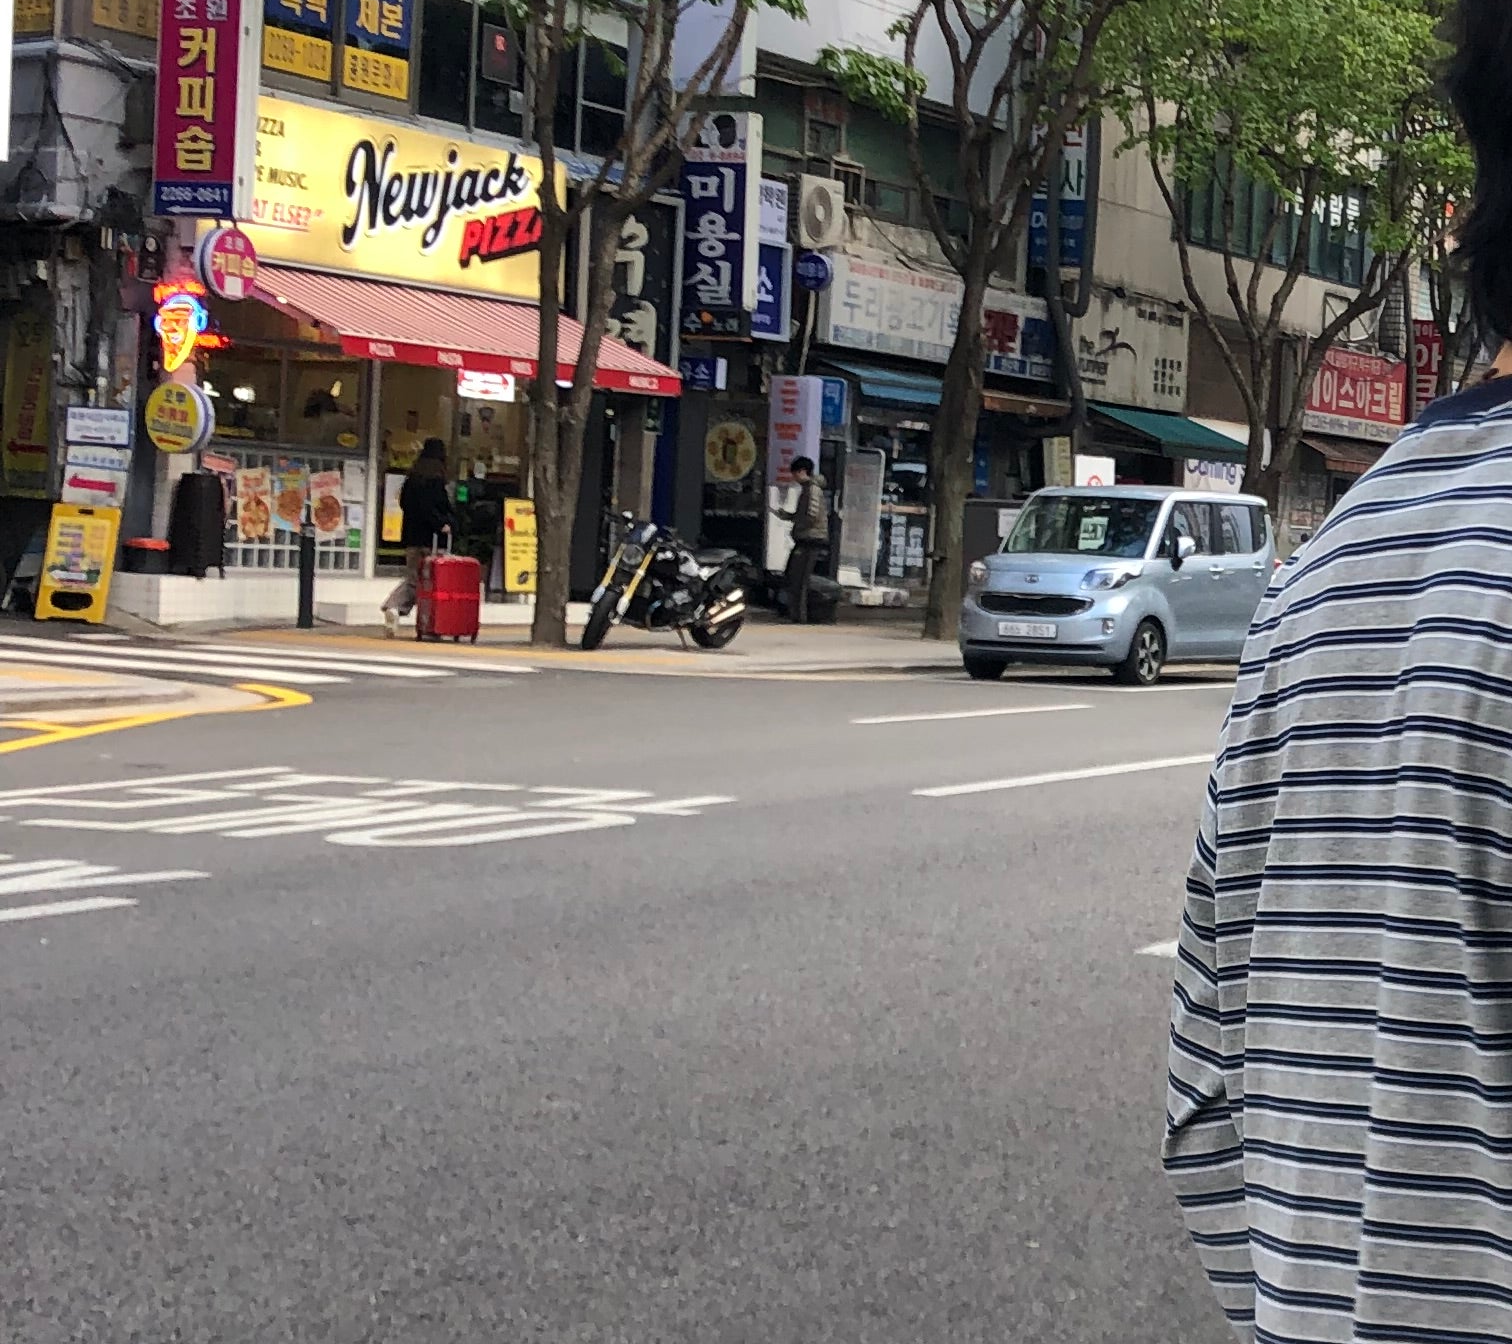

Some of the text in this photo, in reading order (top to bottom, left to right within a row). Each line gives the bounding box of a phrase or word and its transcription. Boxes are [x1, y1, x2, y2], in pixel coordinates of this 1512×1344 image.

[174, 27, 217, 171] 커피숍
[256, 116, 286, 137] IZZA
[252, 198, 269, 218] AT
[341, 138, 526, 249] Newjack
[685, 166, 741, 306] 미용실
